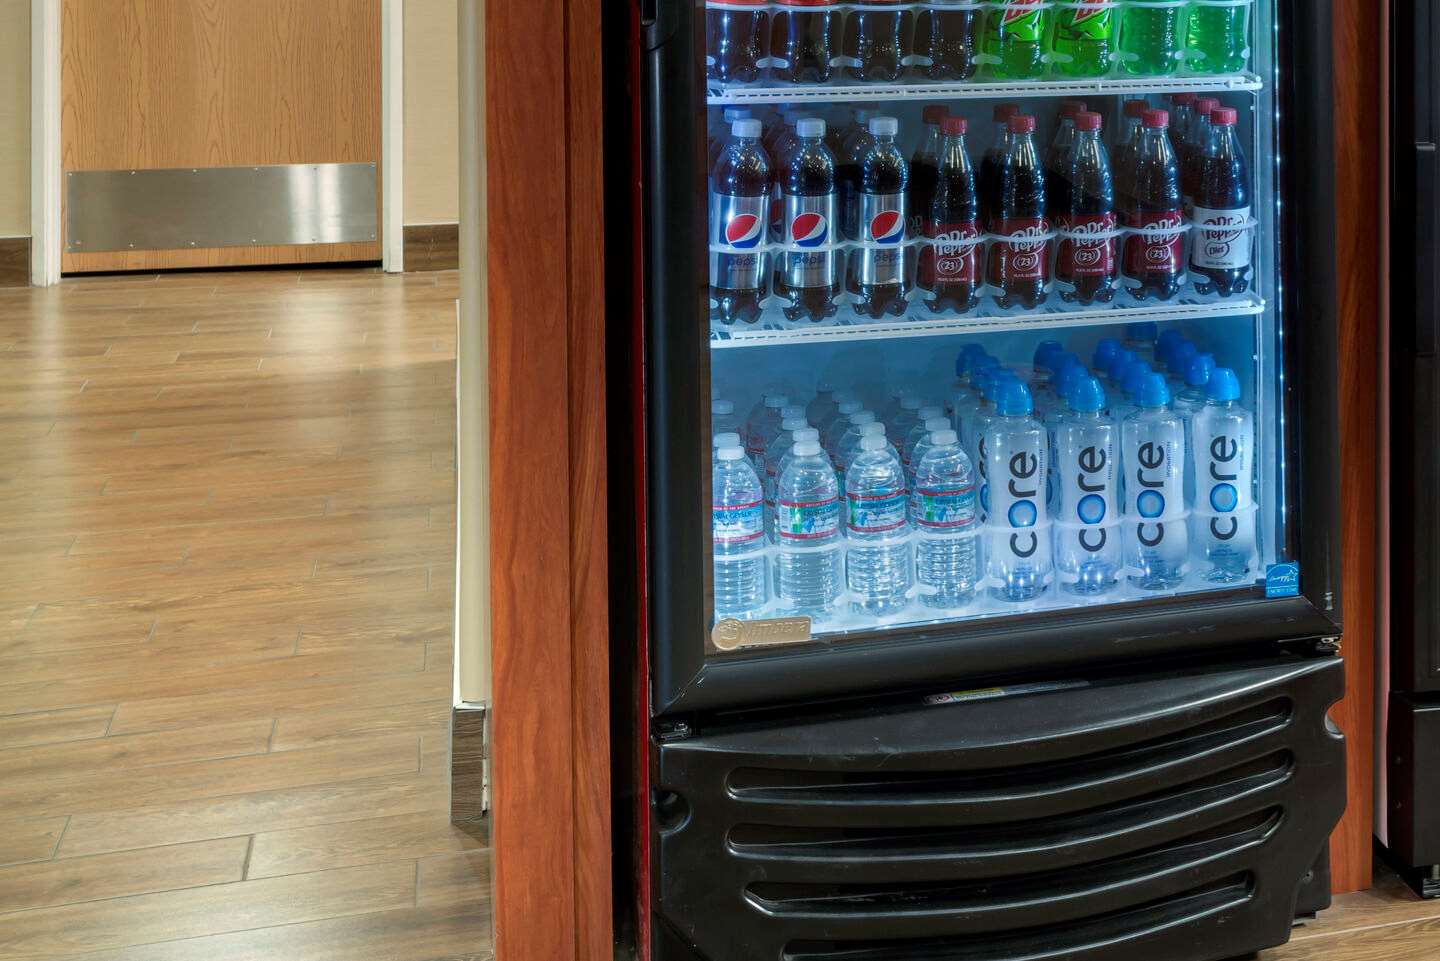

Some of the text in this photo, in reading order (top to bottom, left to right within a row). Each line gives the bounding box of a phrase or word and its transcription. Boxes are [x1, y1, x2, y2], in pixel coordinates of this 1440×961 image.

[1007, 450, 1038, 558] core
[1077, 445, 1107, 553] core
[1136, 441, 1165, 548] core
[1209, 435, 1238, 541] core
